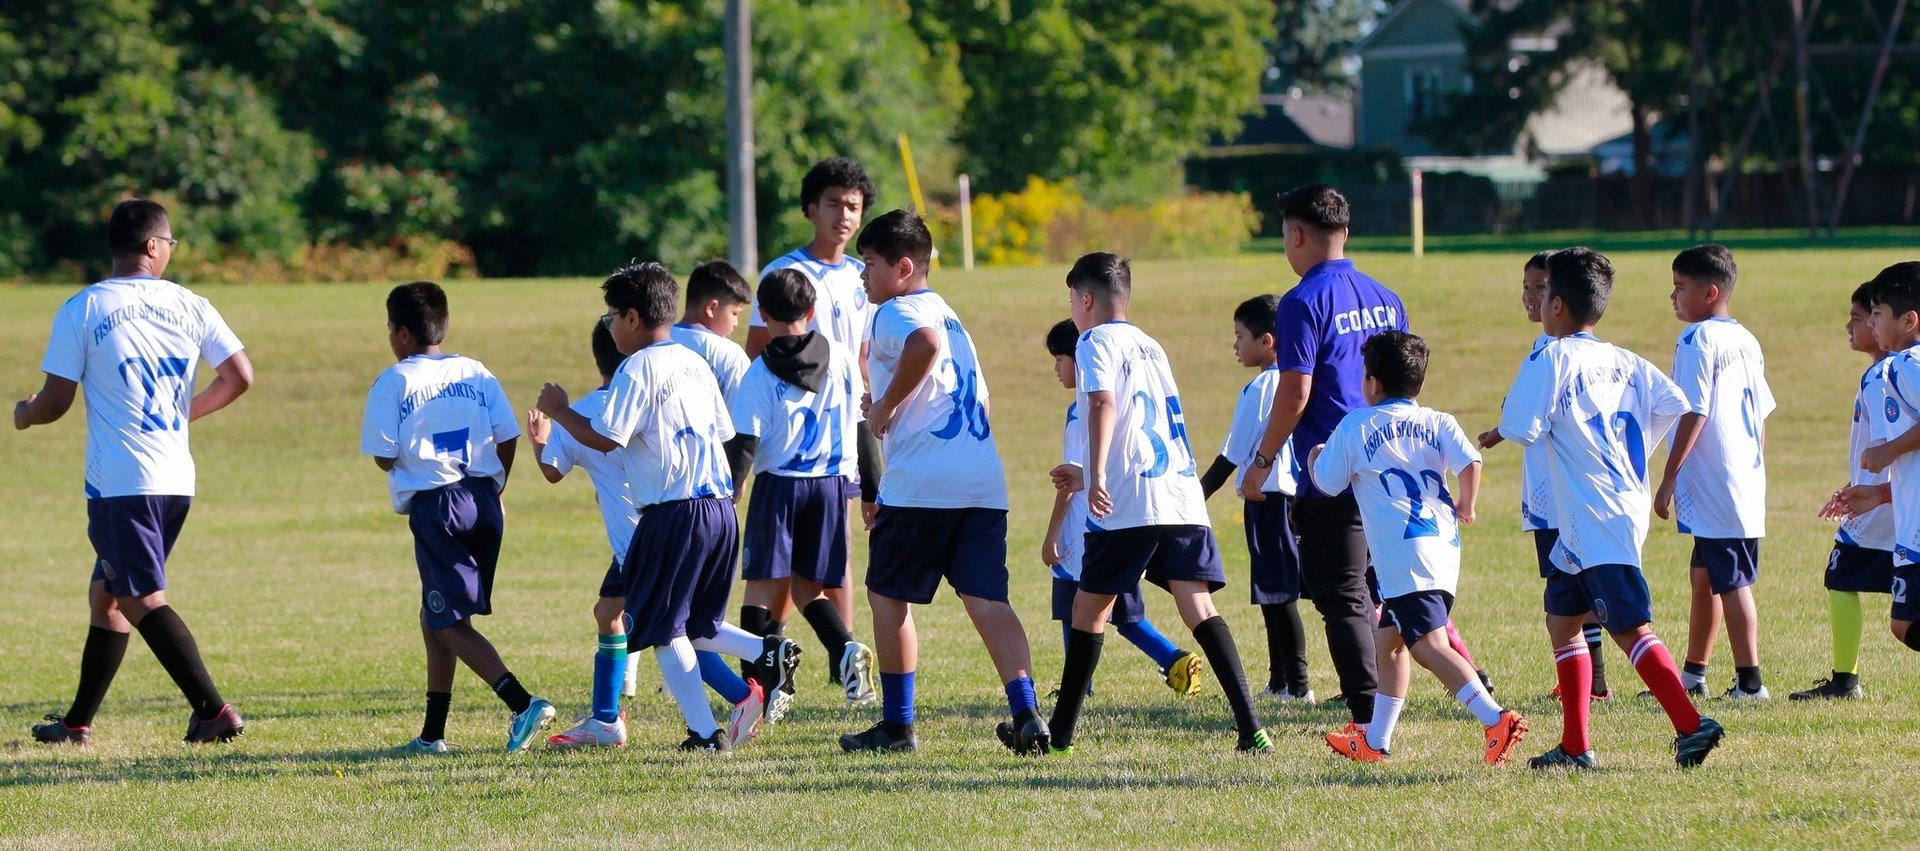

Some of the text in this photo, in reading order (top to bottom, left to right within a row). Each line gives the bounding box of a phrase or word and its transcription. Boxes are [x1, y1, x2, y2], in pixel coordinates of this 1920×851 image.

[93, 304, 137, 346] FISHTAIL
[138, 303, 179, 327] SPORTS
[1334, 305, 1398, 336] COACH
[118, 356, 190, 434] 27
[436, 382, 477, 401] SPORTS
[777, 403, 843, 475] 21
[1132, 390, 1198, 479] 35
[765, 650, 775, 667] UA
